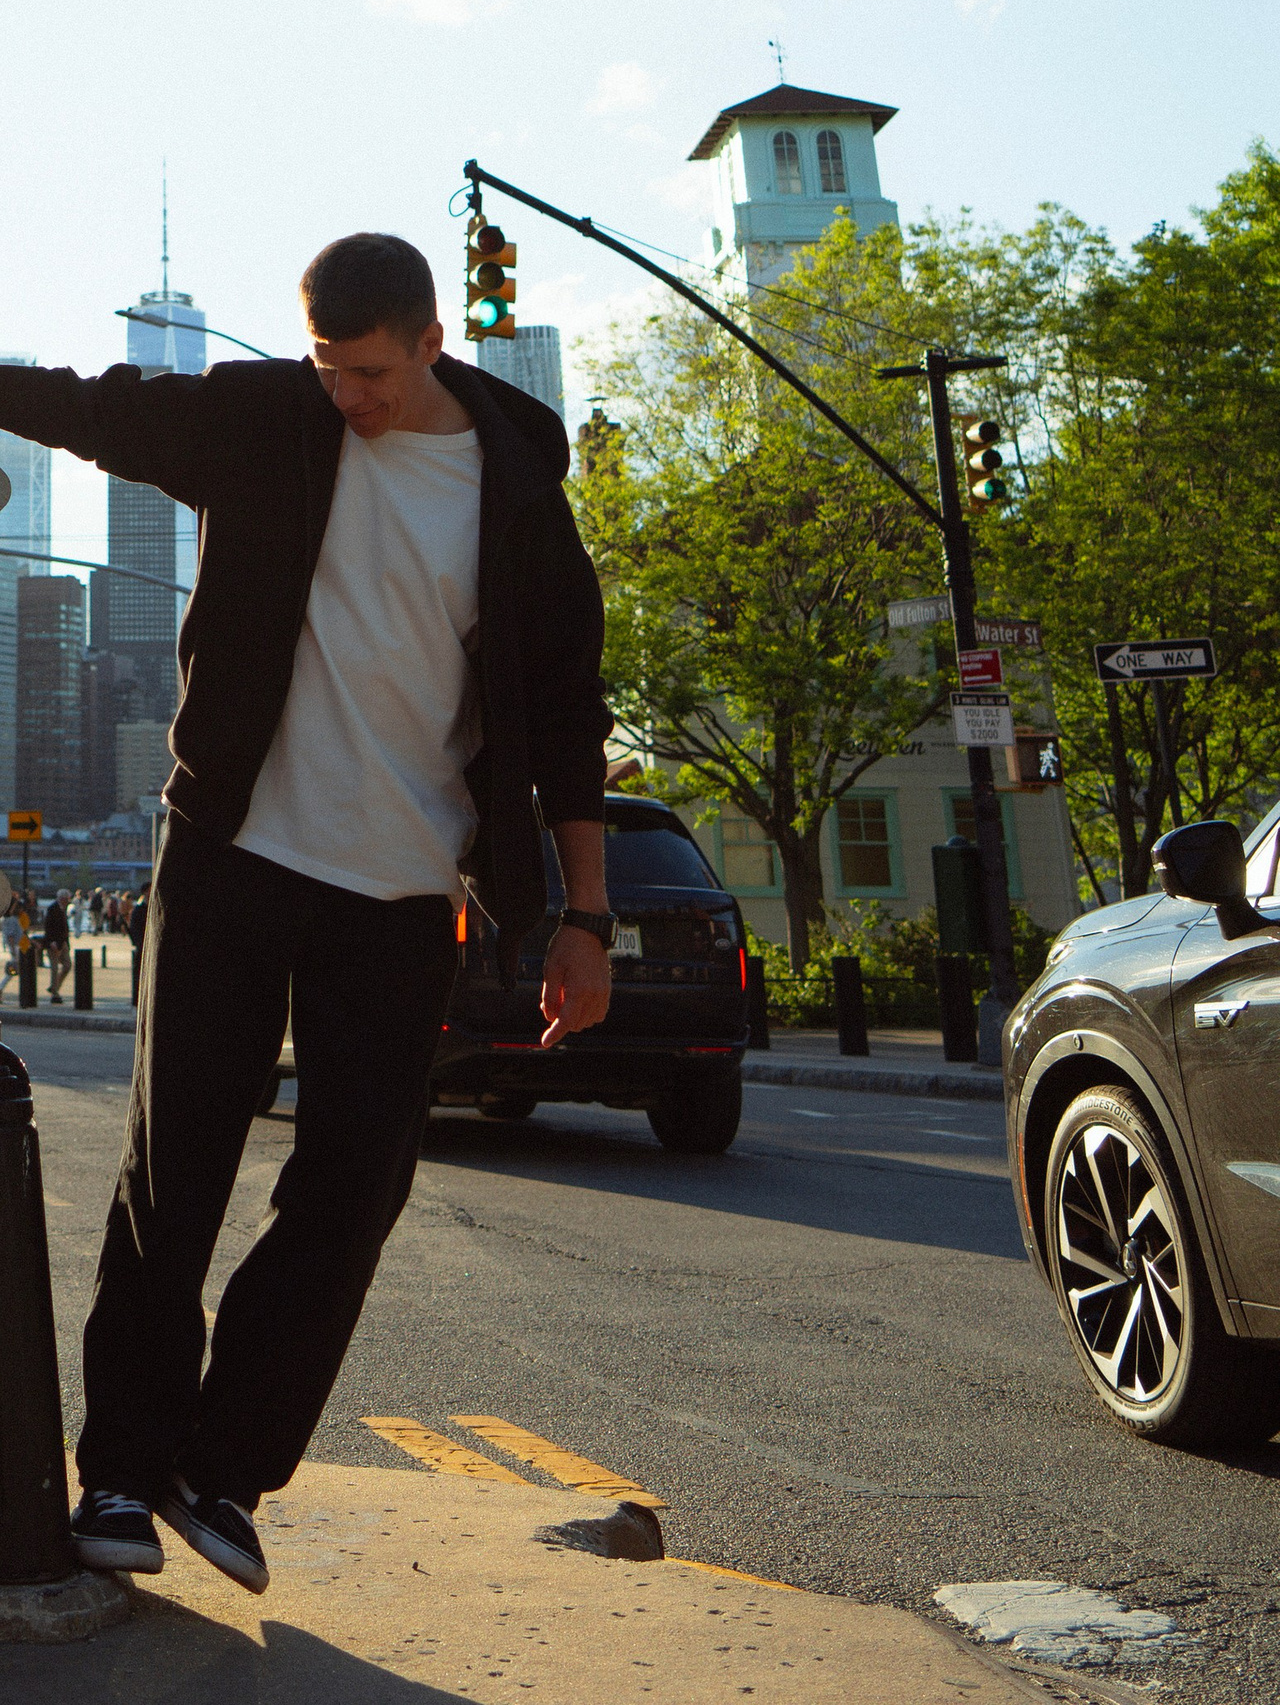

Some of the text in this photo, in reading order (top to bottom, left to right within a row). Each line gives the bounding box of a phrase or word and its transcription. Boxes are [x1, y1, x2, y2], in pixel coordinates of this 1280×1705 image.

[888, 602, 950, 626] Old Fulton St
[978, 625, 1039, 645] Water St
[1116, 651, 1194, 669] ONE WAY
[964, 708, 1000, 717] YOU IDLE
[966, 719, 1000, 727] YOU PAY
[970, 729, 999, 740] $2000
[1194, 1008, 1241, 1029] EV
